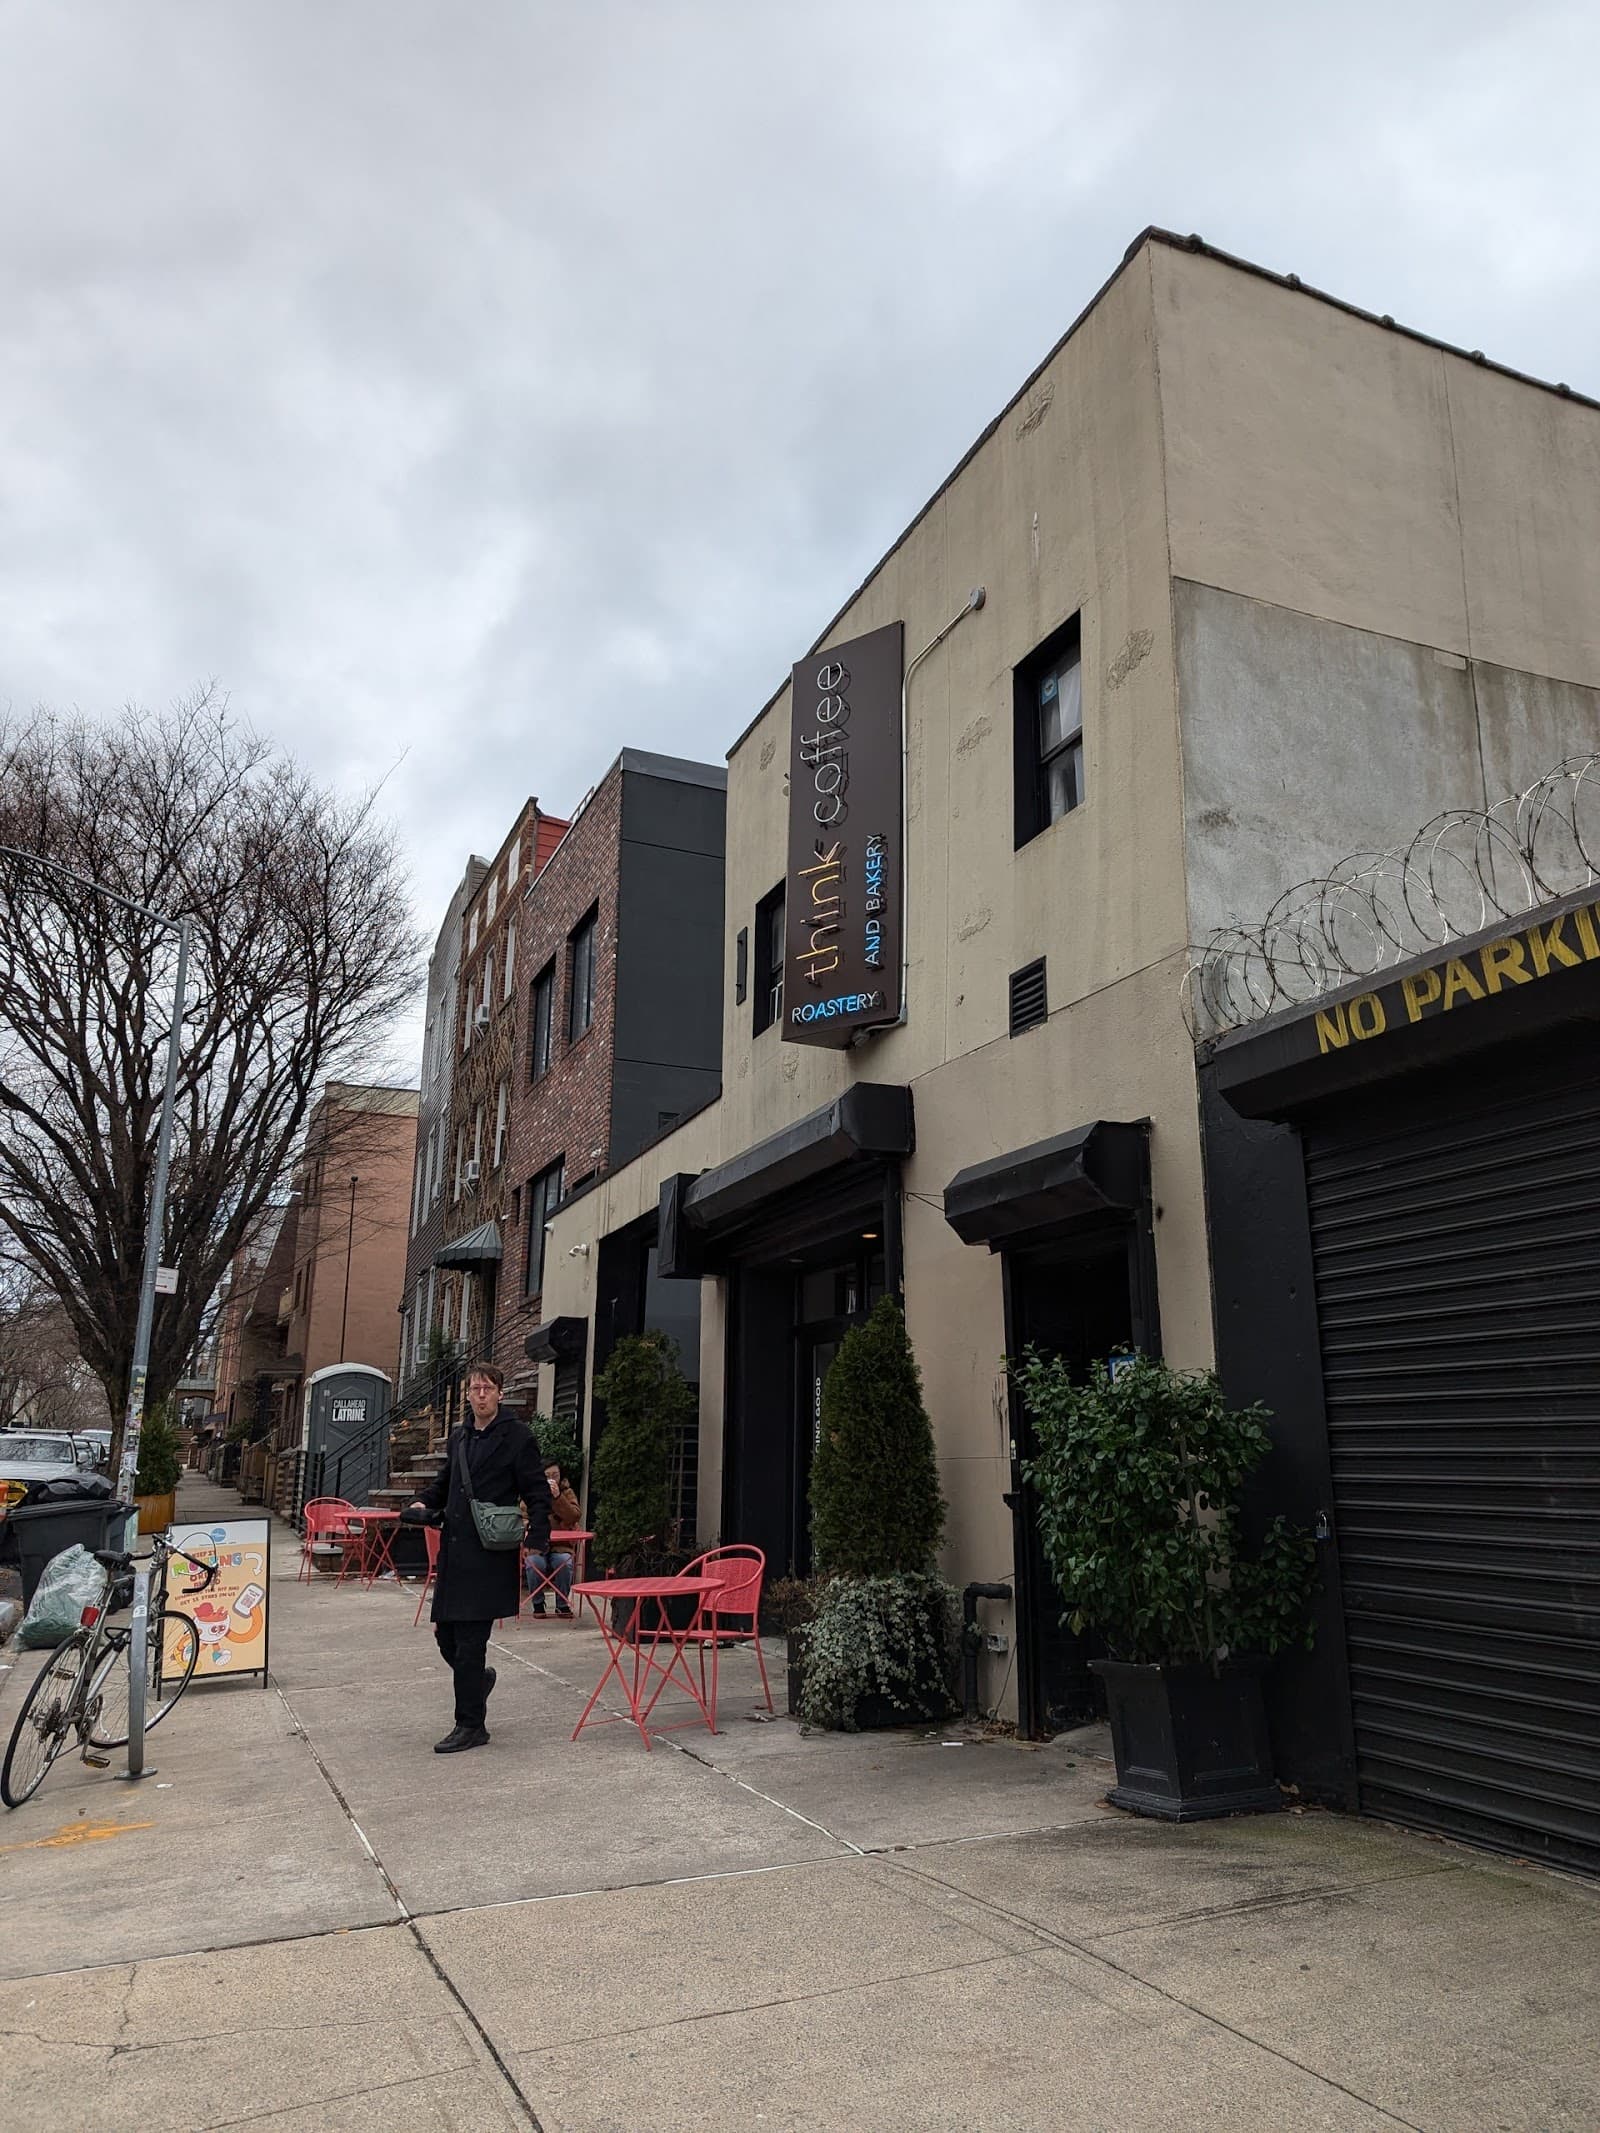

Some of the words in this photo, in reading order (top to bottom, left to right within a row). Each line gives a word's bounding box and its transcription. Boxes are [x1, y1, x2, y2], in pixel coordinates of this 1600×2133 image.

[799, 662, 843, 823] coffee
[865, 834, 882, 911] BAKERY
[796, 841, 841, 980] think
[865, 919, 880, 966] AND
[791, 990, 879, 1024] ROASTERY
[1315, 992, 1387, 1054] NO
[1402, 900, 1600, 1023] PARKI
[332, 1408, 366, 1421] LATRINE
[333, 1399, 366, 1408] CALLAHEAD
